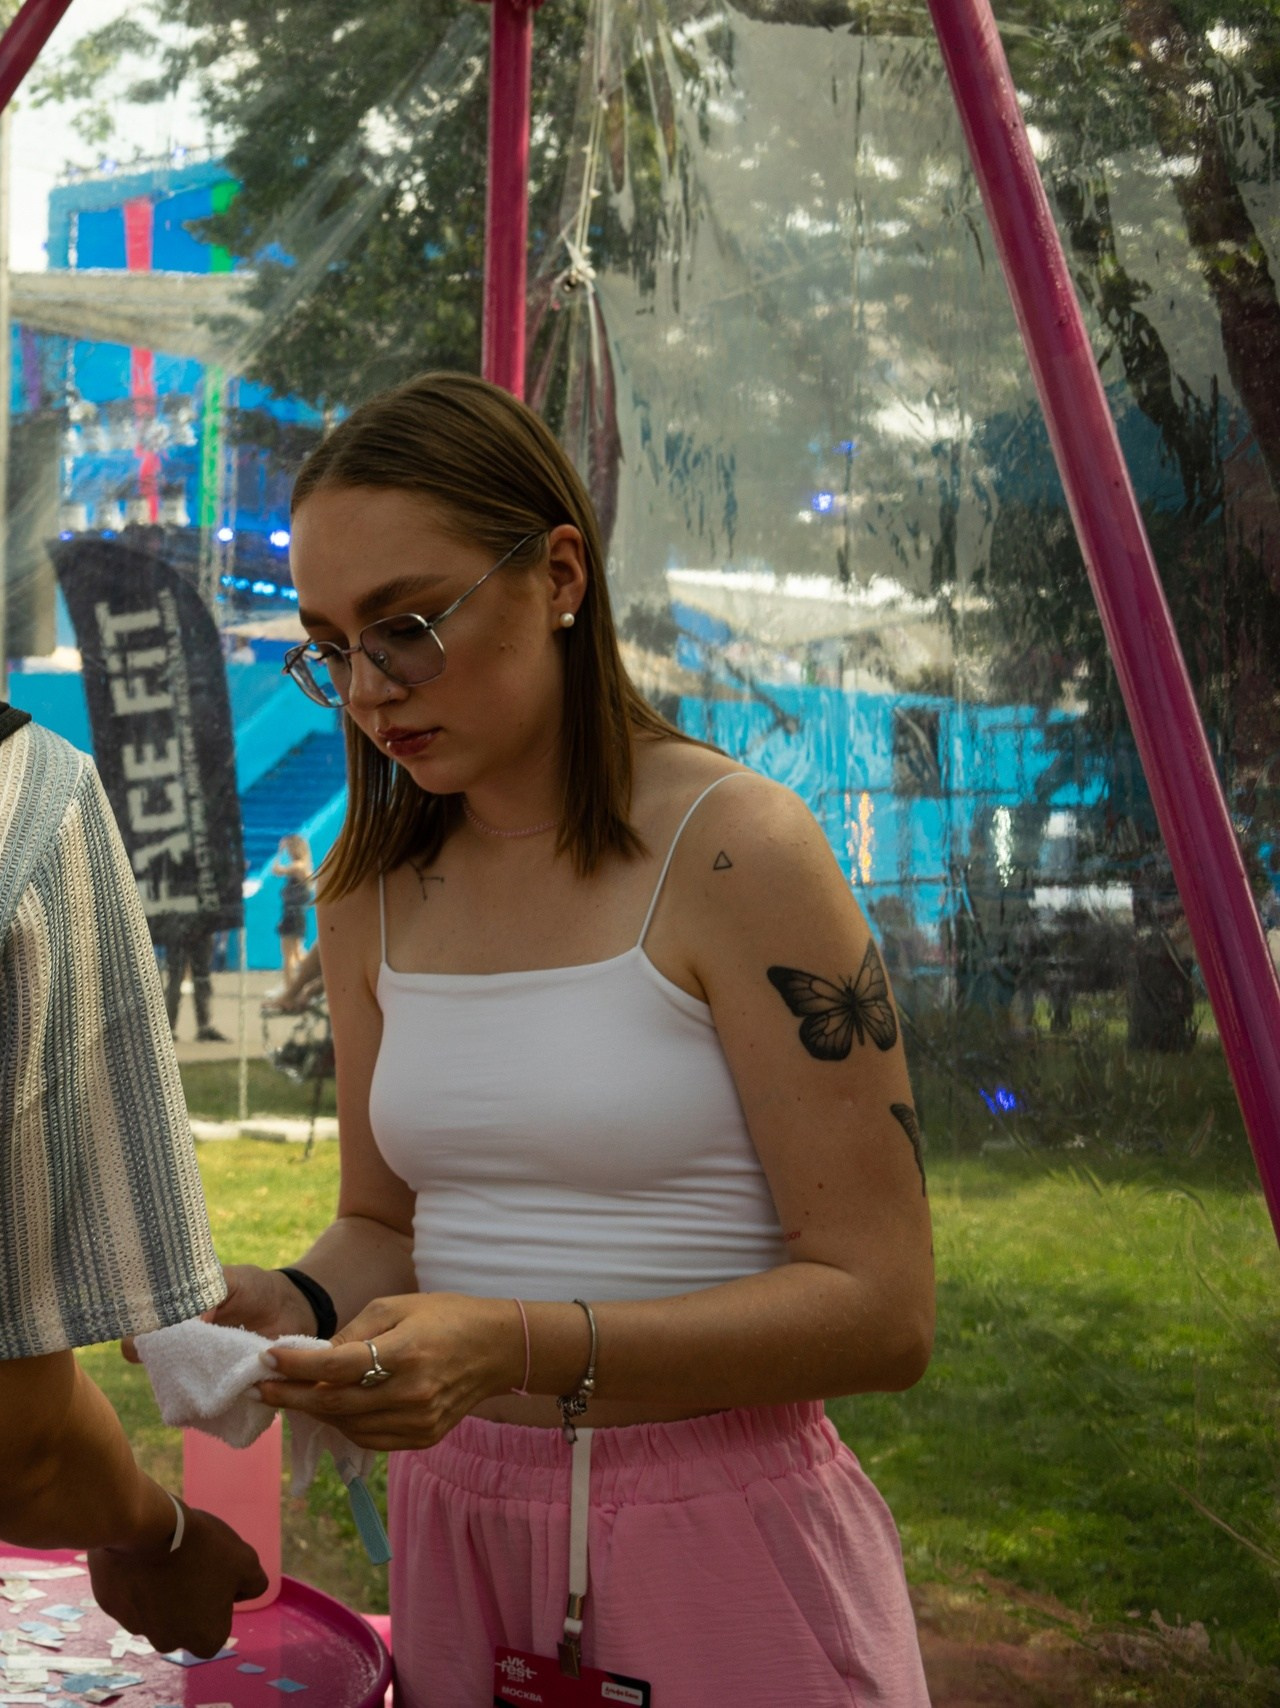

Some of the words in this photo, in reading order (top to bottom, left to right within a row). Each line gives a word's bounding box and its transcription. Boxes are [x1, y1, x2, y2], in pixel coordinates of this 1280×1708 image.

[495, 1659, 538, 1680] fest
[507, 1655, 526, 1668] VK
[501, 1686, 543, 1703] МОСКВА
